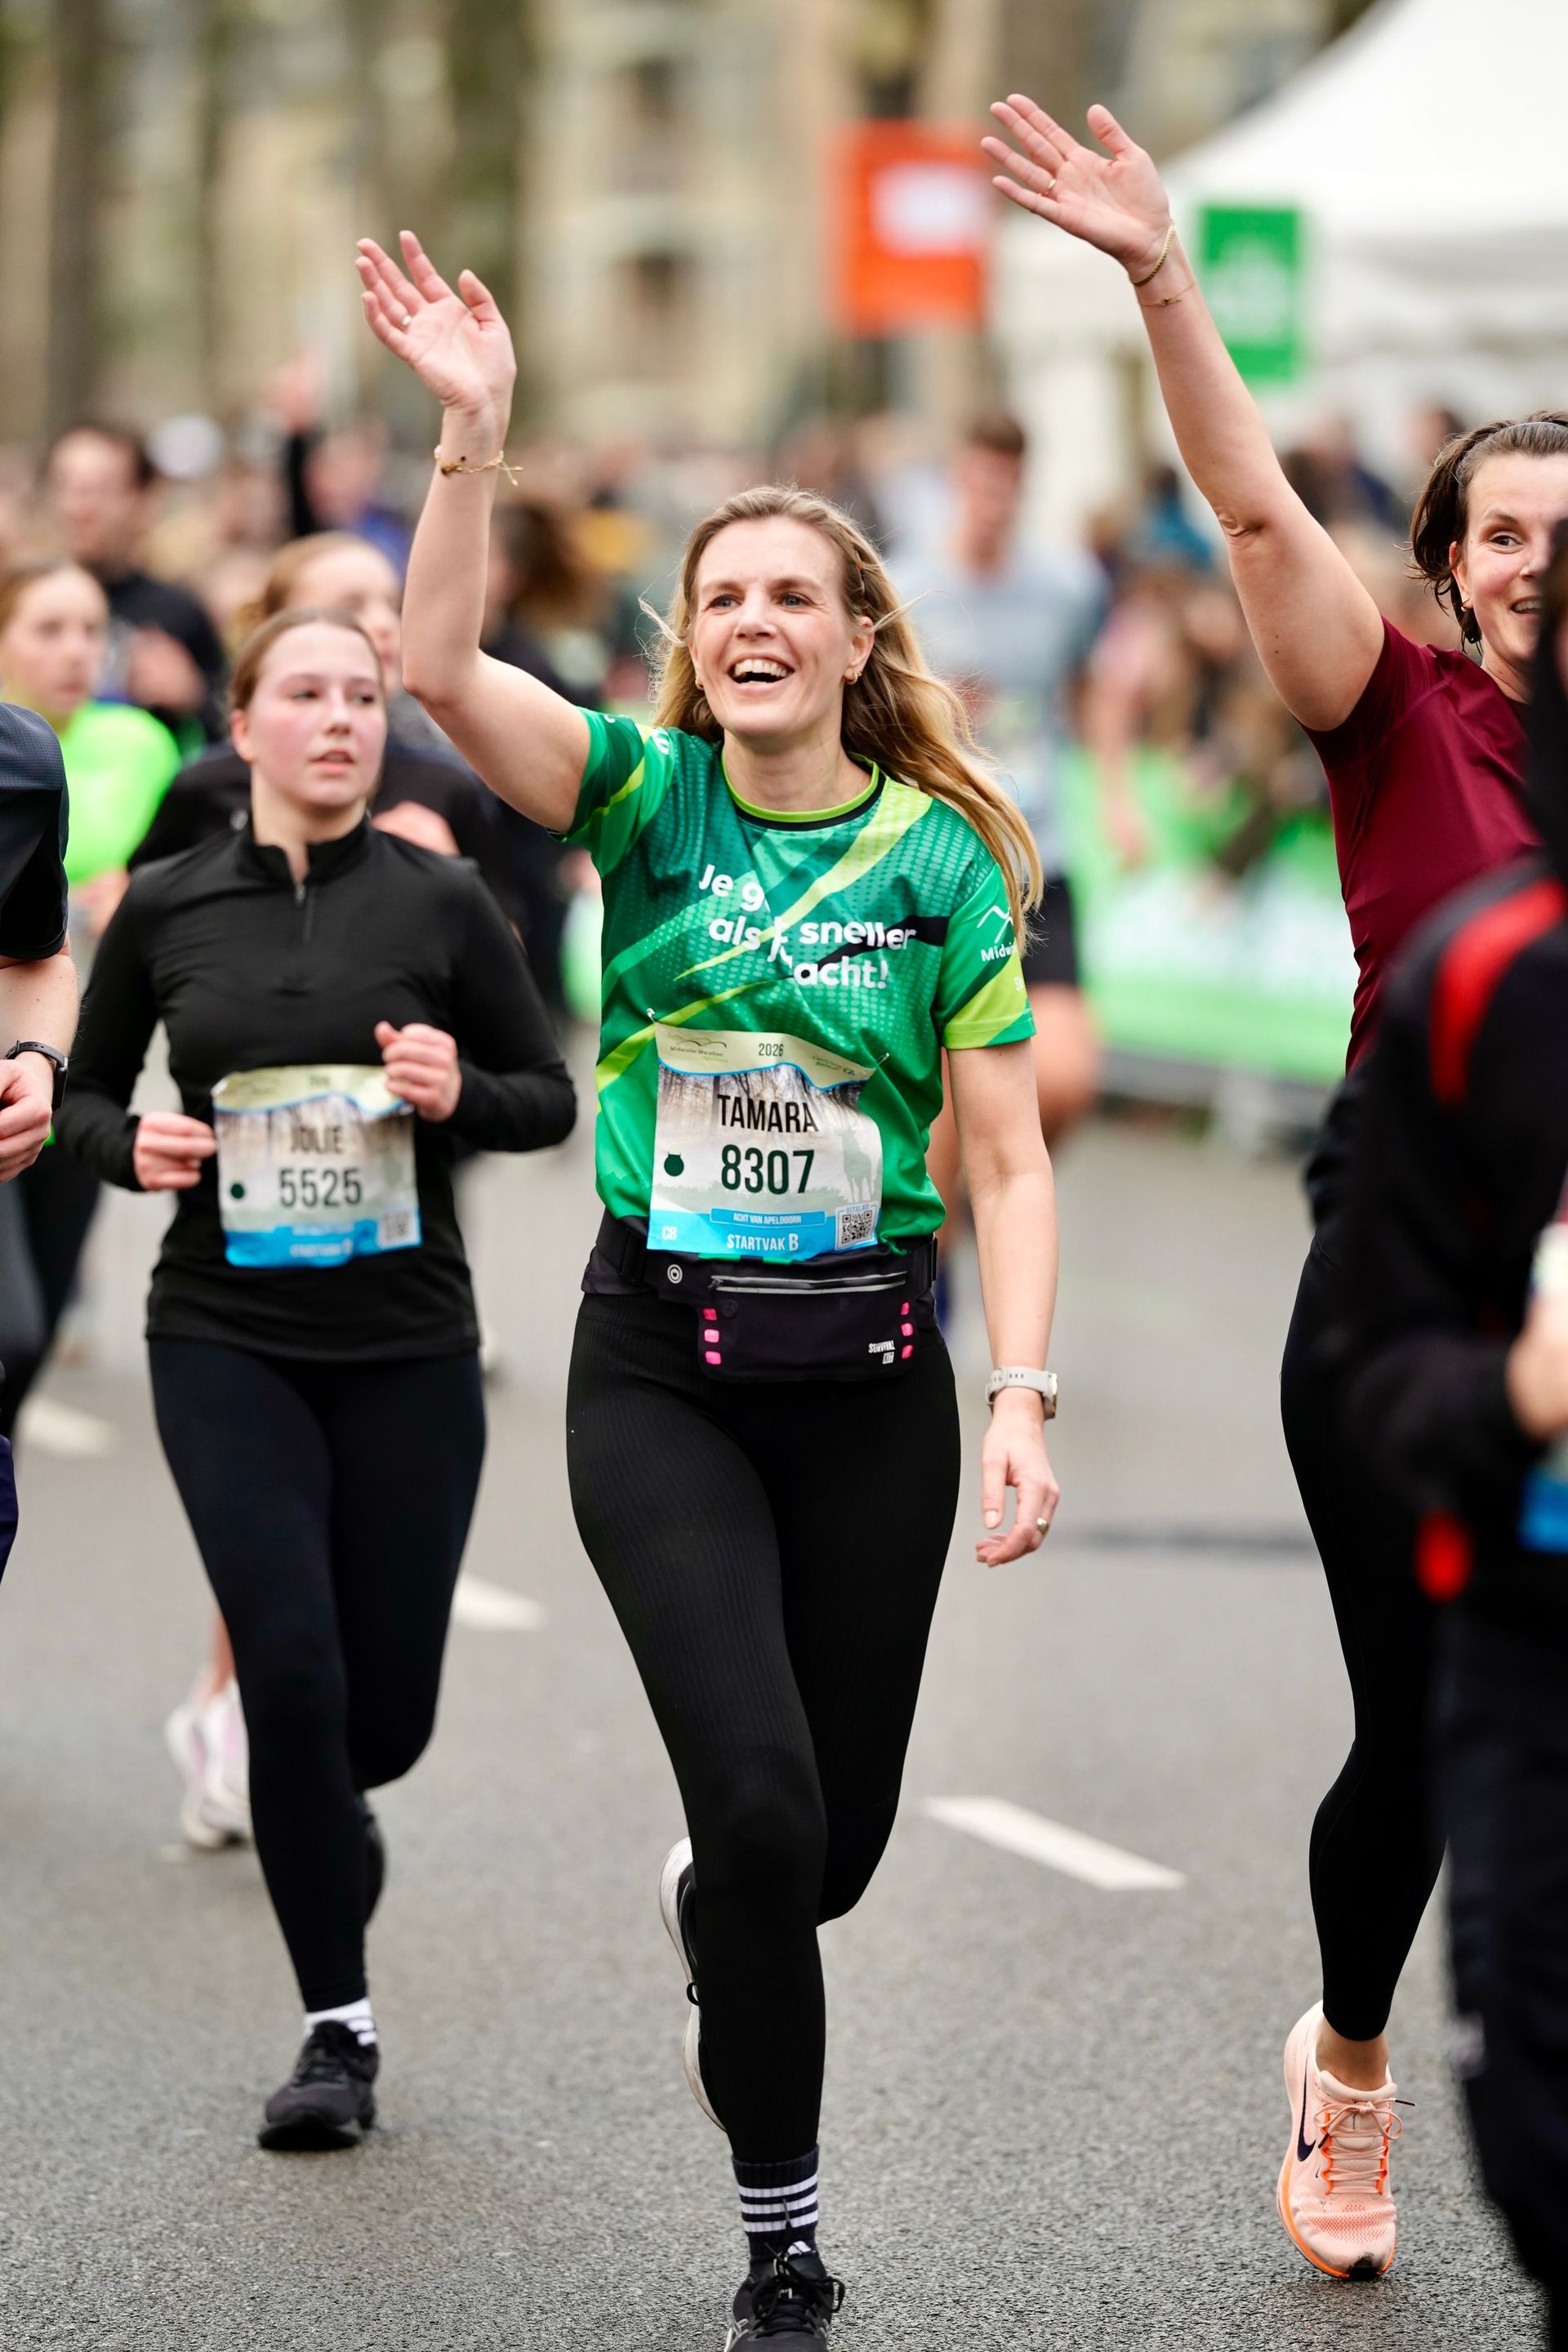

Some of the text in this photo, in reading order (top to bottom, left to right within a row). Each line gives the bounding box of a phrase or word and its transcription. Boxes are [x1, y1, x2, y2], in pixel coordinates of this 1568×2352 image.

[698, 863, 733, 898] Je
[799, 920, 917, 950] sneller
[708, 915, 761, 951] als
[793, 955, 889, 990] acht!
[758, 1042, 784, 1058] 2026
[717, 1094, 819, 1134] TAMARA
[278, 1166, 363, 1209] 5525
[721, 1143, 815, 1195] 8307
[727, 1232, 800, 1251] STARTVAK B
